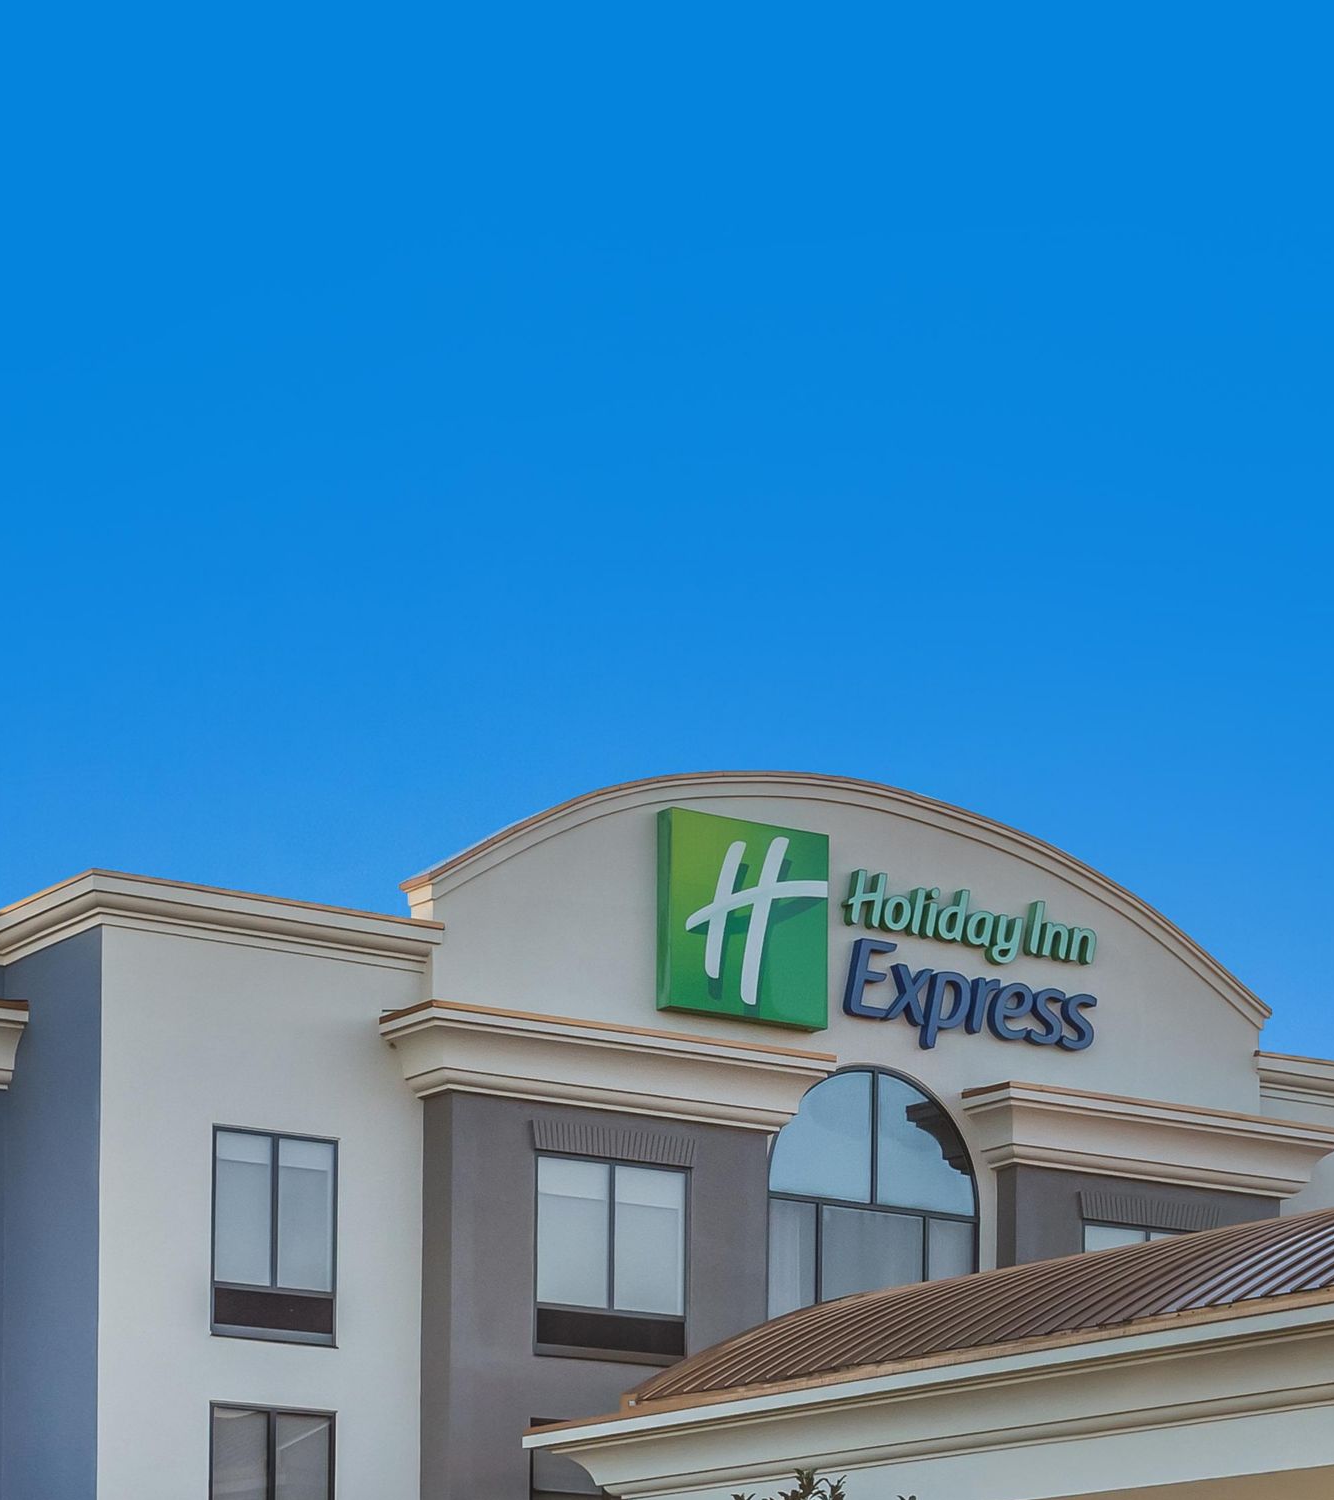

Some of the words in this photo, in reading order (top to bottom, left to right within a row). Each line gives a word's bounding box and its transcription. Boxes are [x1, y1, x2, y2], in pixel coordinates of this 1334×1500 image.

[841, 868, 1024, 965] Holiday
[1024, 900, 1097, 966] Inn
[842, 938, 1098, 1051] Express
